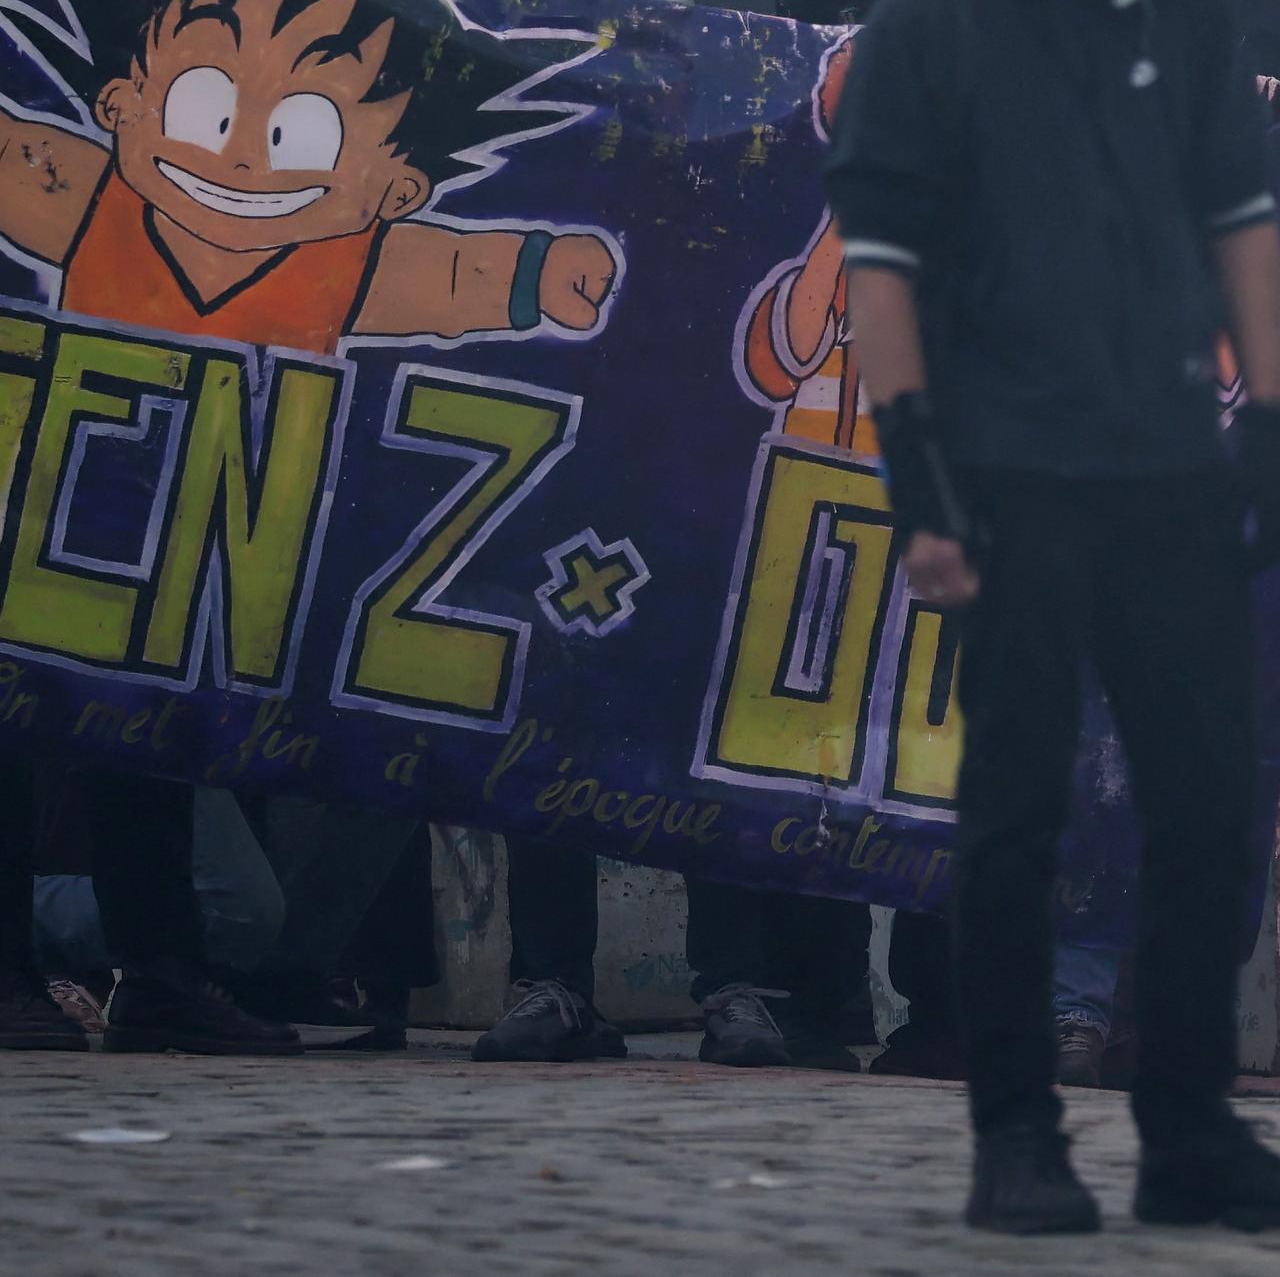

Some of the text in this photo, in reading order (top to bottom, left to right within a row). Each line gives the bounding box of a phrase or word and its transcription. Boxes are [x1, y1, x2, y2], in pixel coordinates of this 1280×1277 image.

[72, 696, 194, 752] met
[205, 693, 321, 780] fin
[770, 815, 957, 906] contemp
